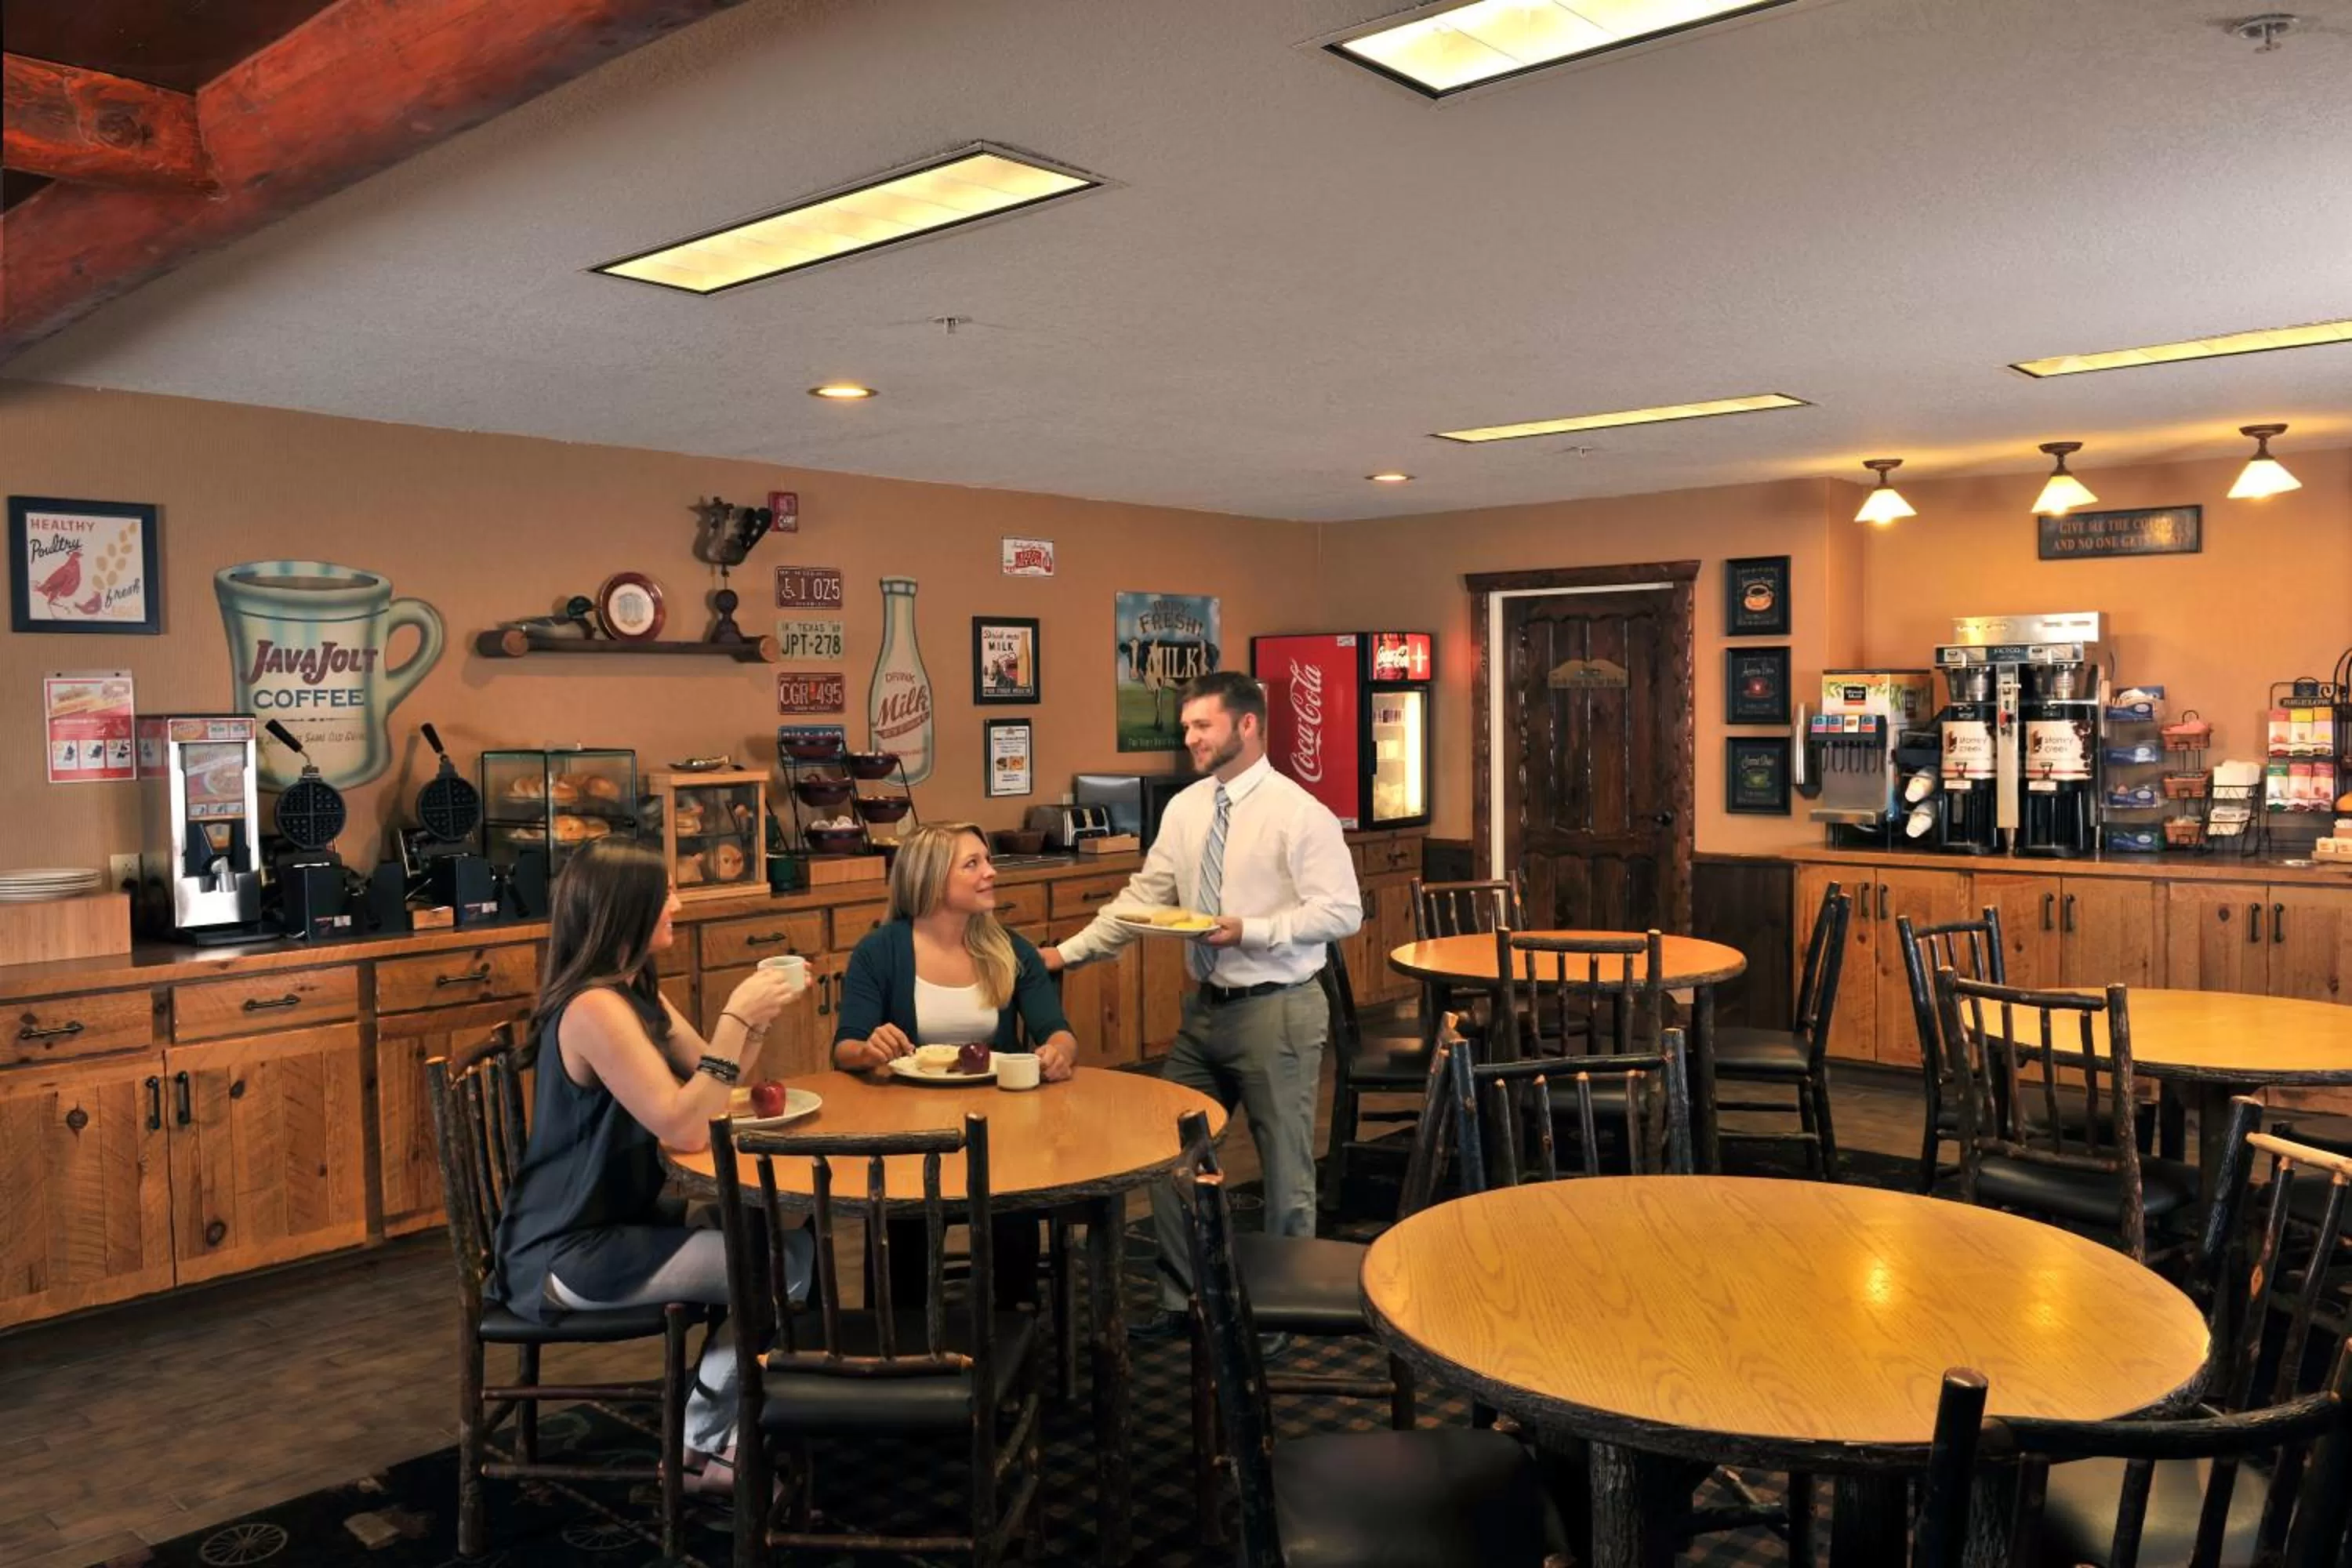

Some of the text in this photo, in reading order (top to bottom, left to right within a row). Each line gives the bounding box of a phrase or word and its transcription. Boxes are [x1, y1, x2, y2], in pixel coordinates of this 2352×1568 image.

[31, 518, 96, 532] HEALTHY
[30, 533, 82, 564] Poultry
[2053, 537, 2075, 552] AND
[989, 641, 1014, 652] MILK
[1146, 643, 1199, 678] MILK
[253, 688, 365, 709] COFFEE
[871, 685, 929, 728] Milk
[1290, 656, 1323, 782] Coca-Cola
